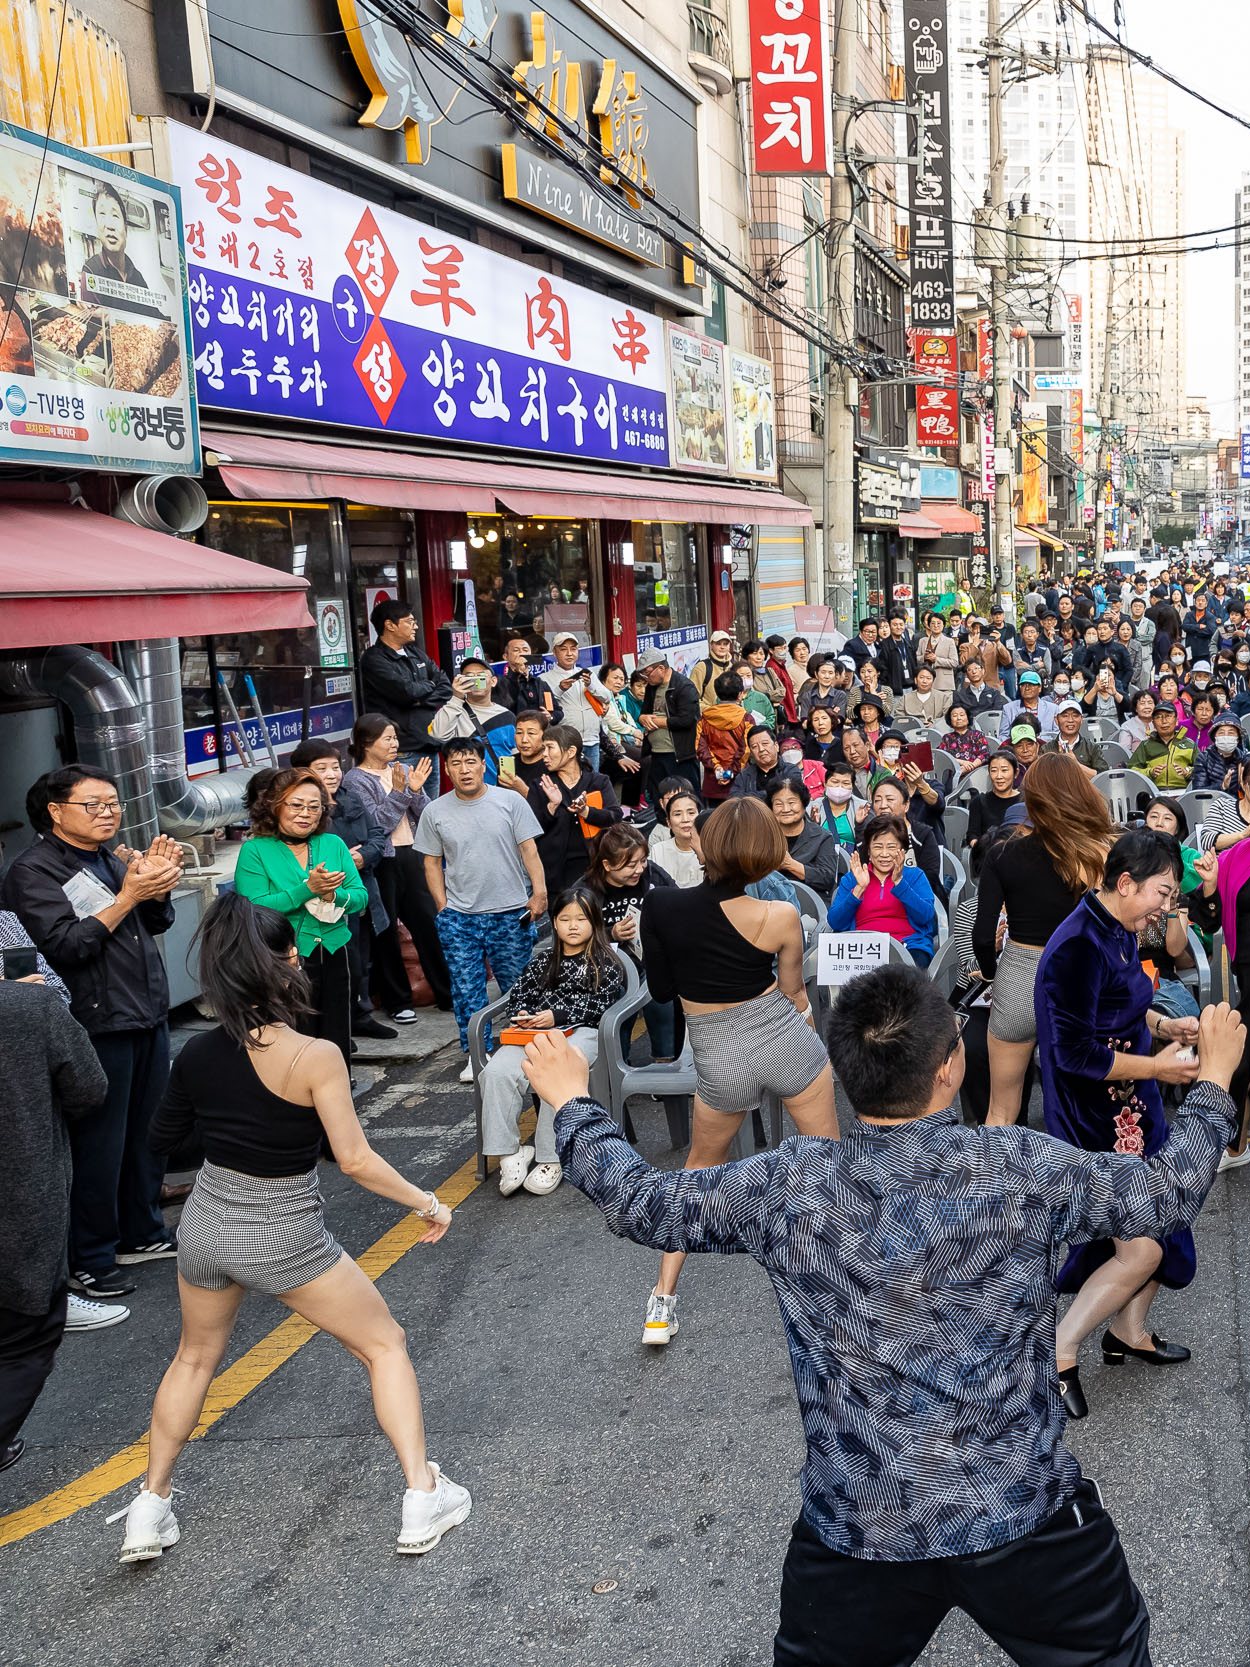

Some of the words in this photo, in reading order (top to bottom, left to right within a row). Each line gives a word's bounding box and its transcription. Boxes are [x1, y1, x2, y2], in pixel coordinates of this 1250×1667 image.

[194, 153, 303, 239] 원조
[527, 162, 574, 215] Nine
[579, 189, 631, 244] Whale
[636, 222, 661, 258] Bar
[915, 251, 949, 270] HOF
[189, 273, 321, 354] 양꼬치거리
[411, 237, 650, 376] 羊肉串
[912, 281, 953, 299] 463-
[912, 302, 952, 320] 1833
[194, 340, 328, 407] 선두주자
[421, 338, 618, 450] 양꼬치구이
[105, 402, 187, 450] 생생정보통
[624, 429, 665, 451] 467-6880
[204, 735, 216, 754] 老
[828, 942, 881, 961] 내빈석
